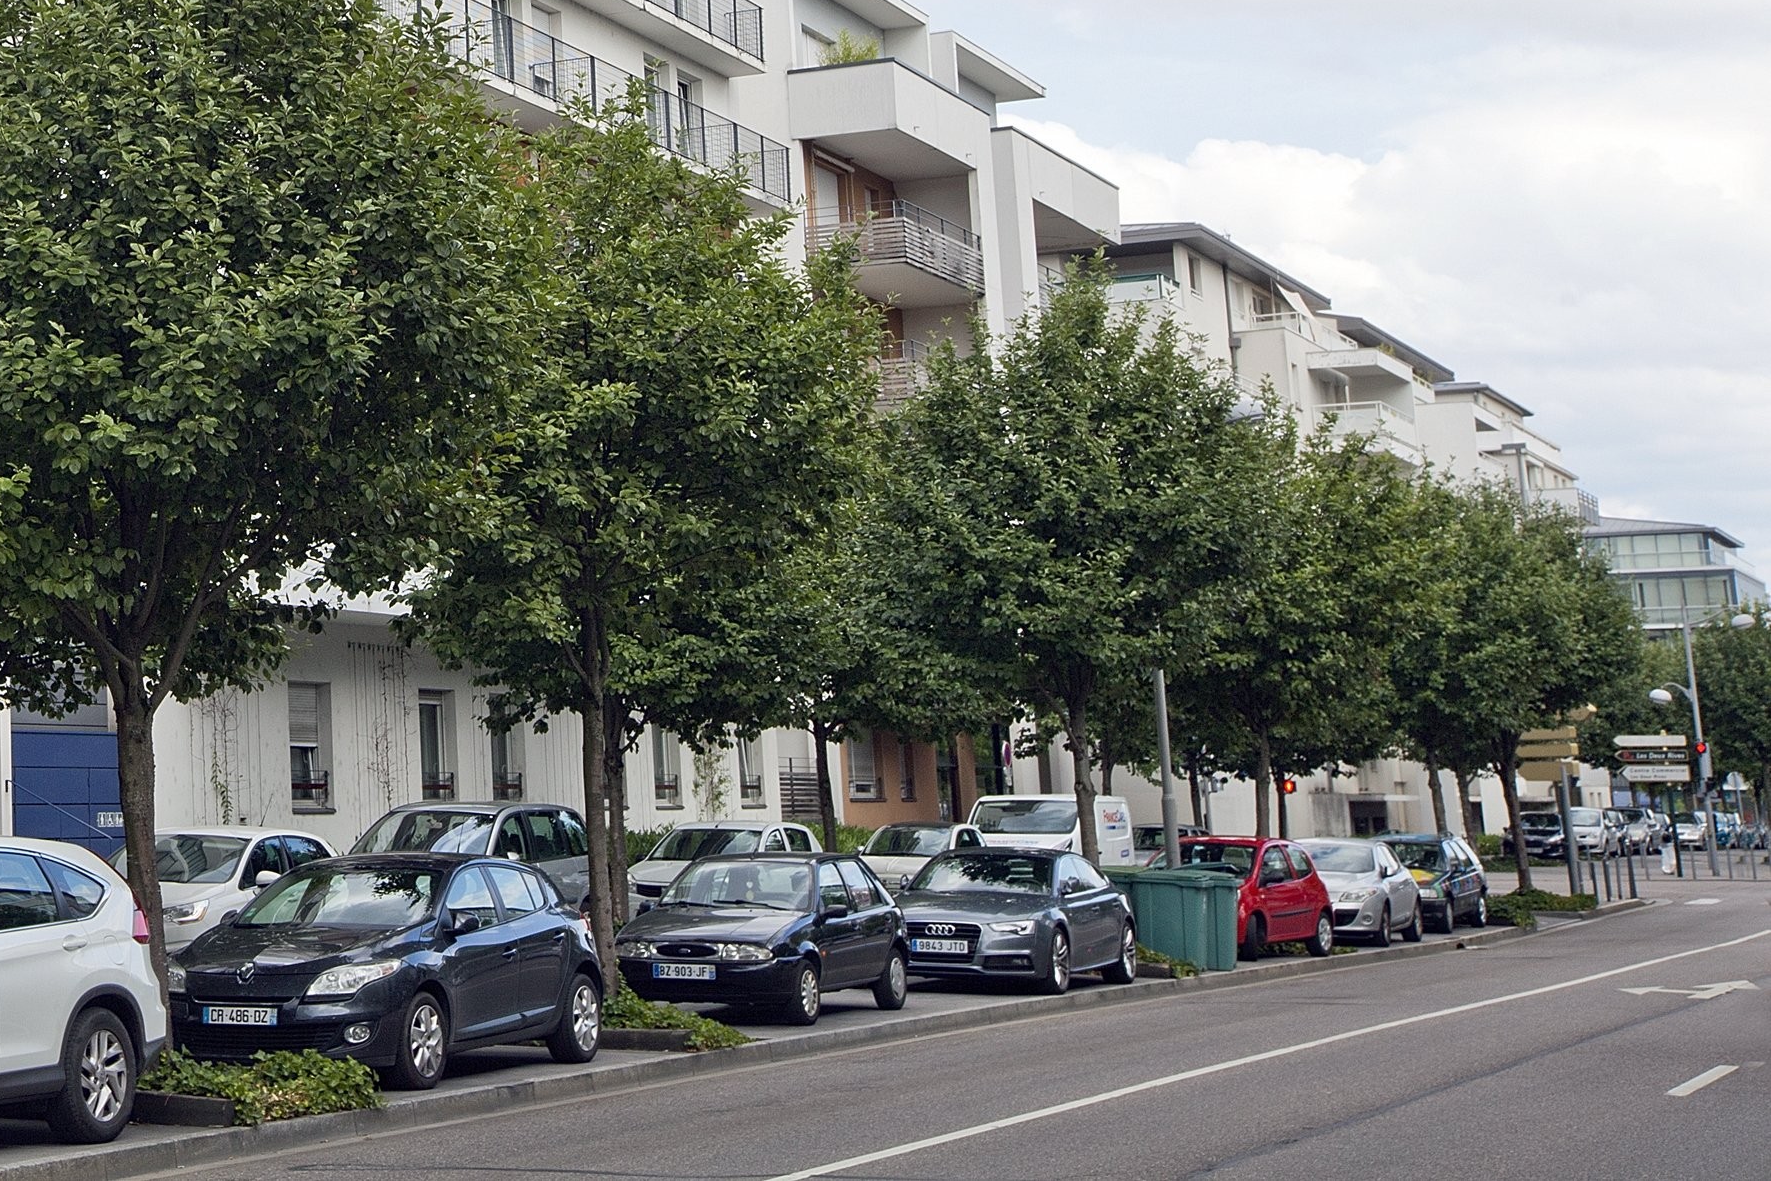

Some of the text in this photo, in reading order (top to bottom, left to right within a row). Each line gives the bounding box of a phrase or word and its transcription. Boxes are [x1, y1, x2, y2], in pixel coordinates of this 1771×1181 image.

[919, 940, 965, 952] 9843 JTD
[659, 965, 707, 977] BZ-903-JF
[210, 1009, 268, 1023] CR-486-DZ
